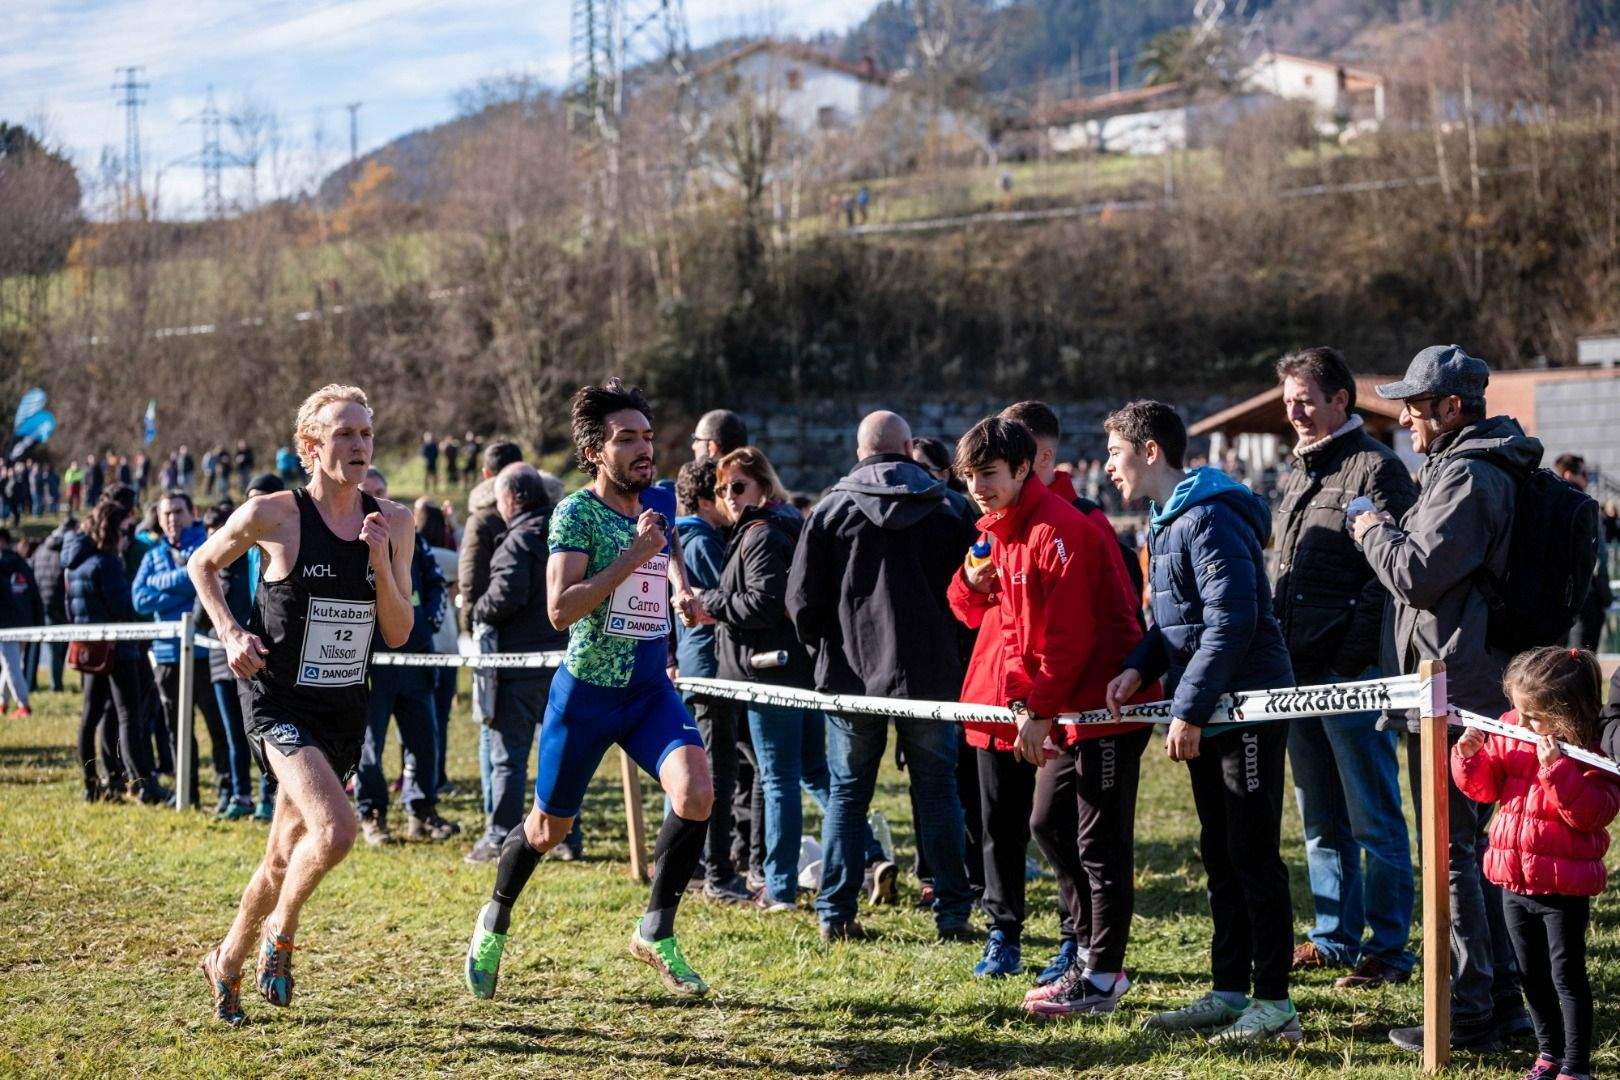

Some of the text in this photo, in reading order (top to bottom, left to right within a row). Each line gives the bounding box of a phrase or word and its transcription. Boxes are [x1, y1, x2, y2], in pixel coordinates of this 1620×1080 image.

[641, 581, 649, 593] 8
[313, 604, 374, 620] kutxabank
[628, 596, 660, 613] Carro
[627, 620, 667, 632] DANOBAT
[334, 629, 353, 642] 12
[319, 644, 357, 660] Nilsson
[321, 667, 361, 679] DANOBAT
[1099, 738, 1117, 791] Joma
[1242, 732, 1260, 793] Joma
